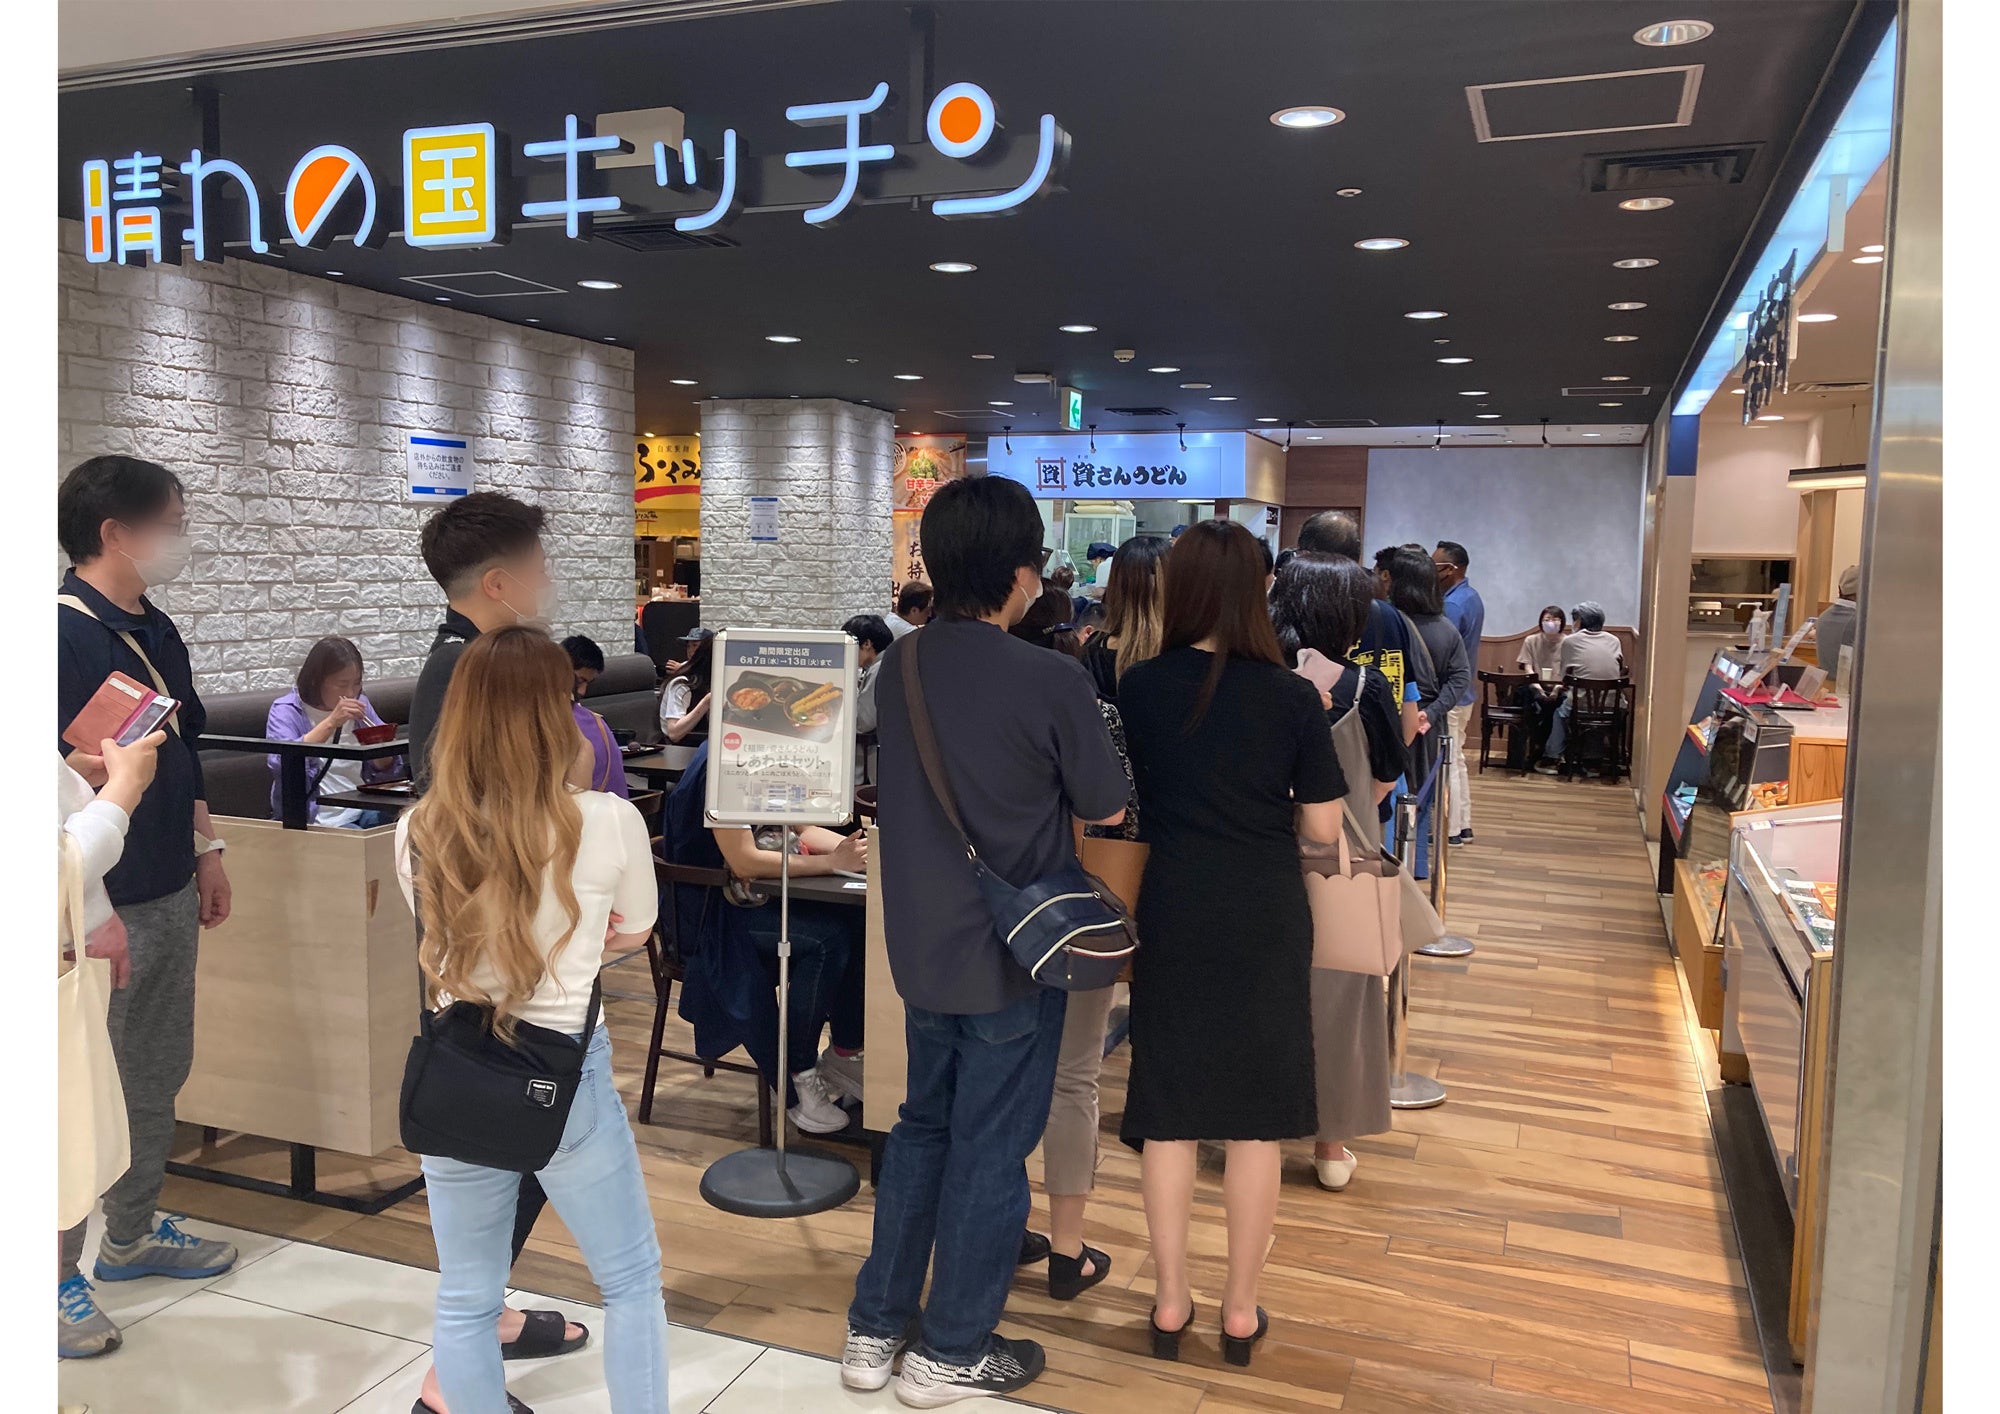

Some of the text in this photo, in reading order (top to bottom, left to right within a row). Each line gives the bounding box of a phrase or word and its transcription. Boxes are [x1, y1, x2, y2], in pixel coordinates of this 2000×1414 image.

[83, 82, 1055, 264] 晴れの国キッチン
[906, 478, 947, 491] 甘辛ラー
[1042, 461, 1187, 488] 資 資さんうどん
[758, 646, 811, 657] 期間限定出店
